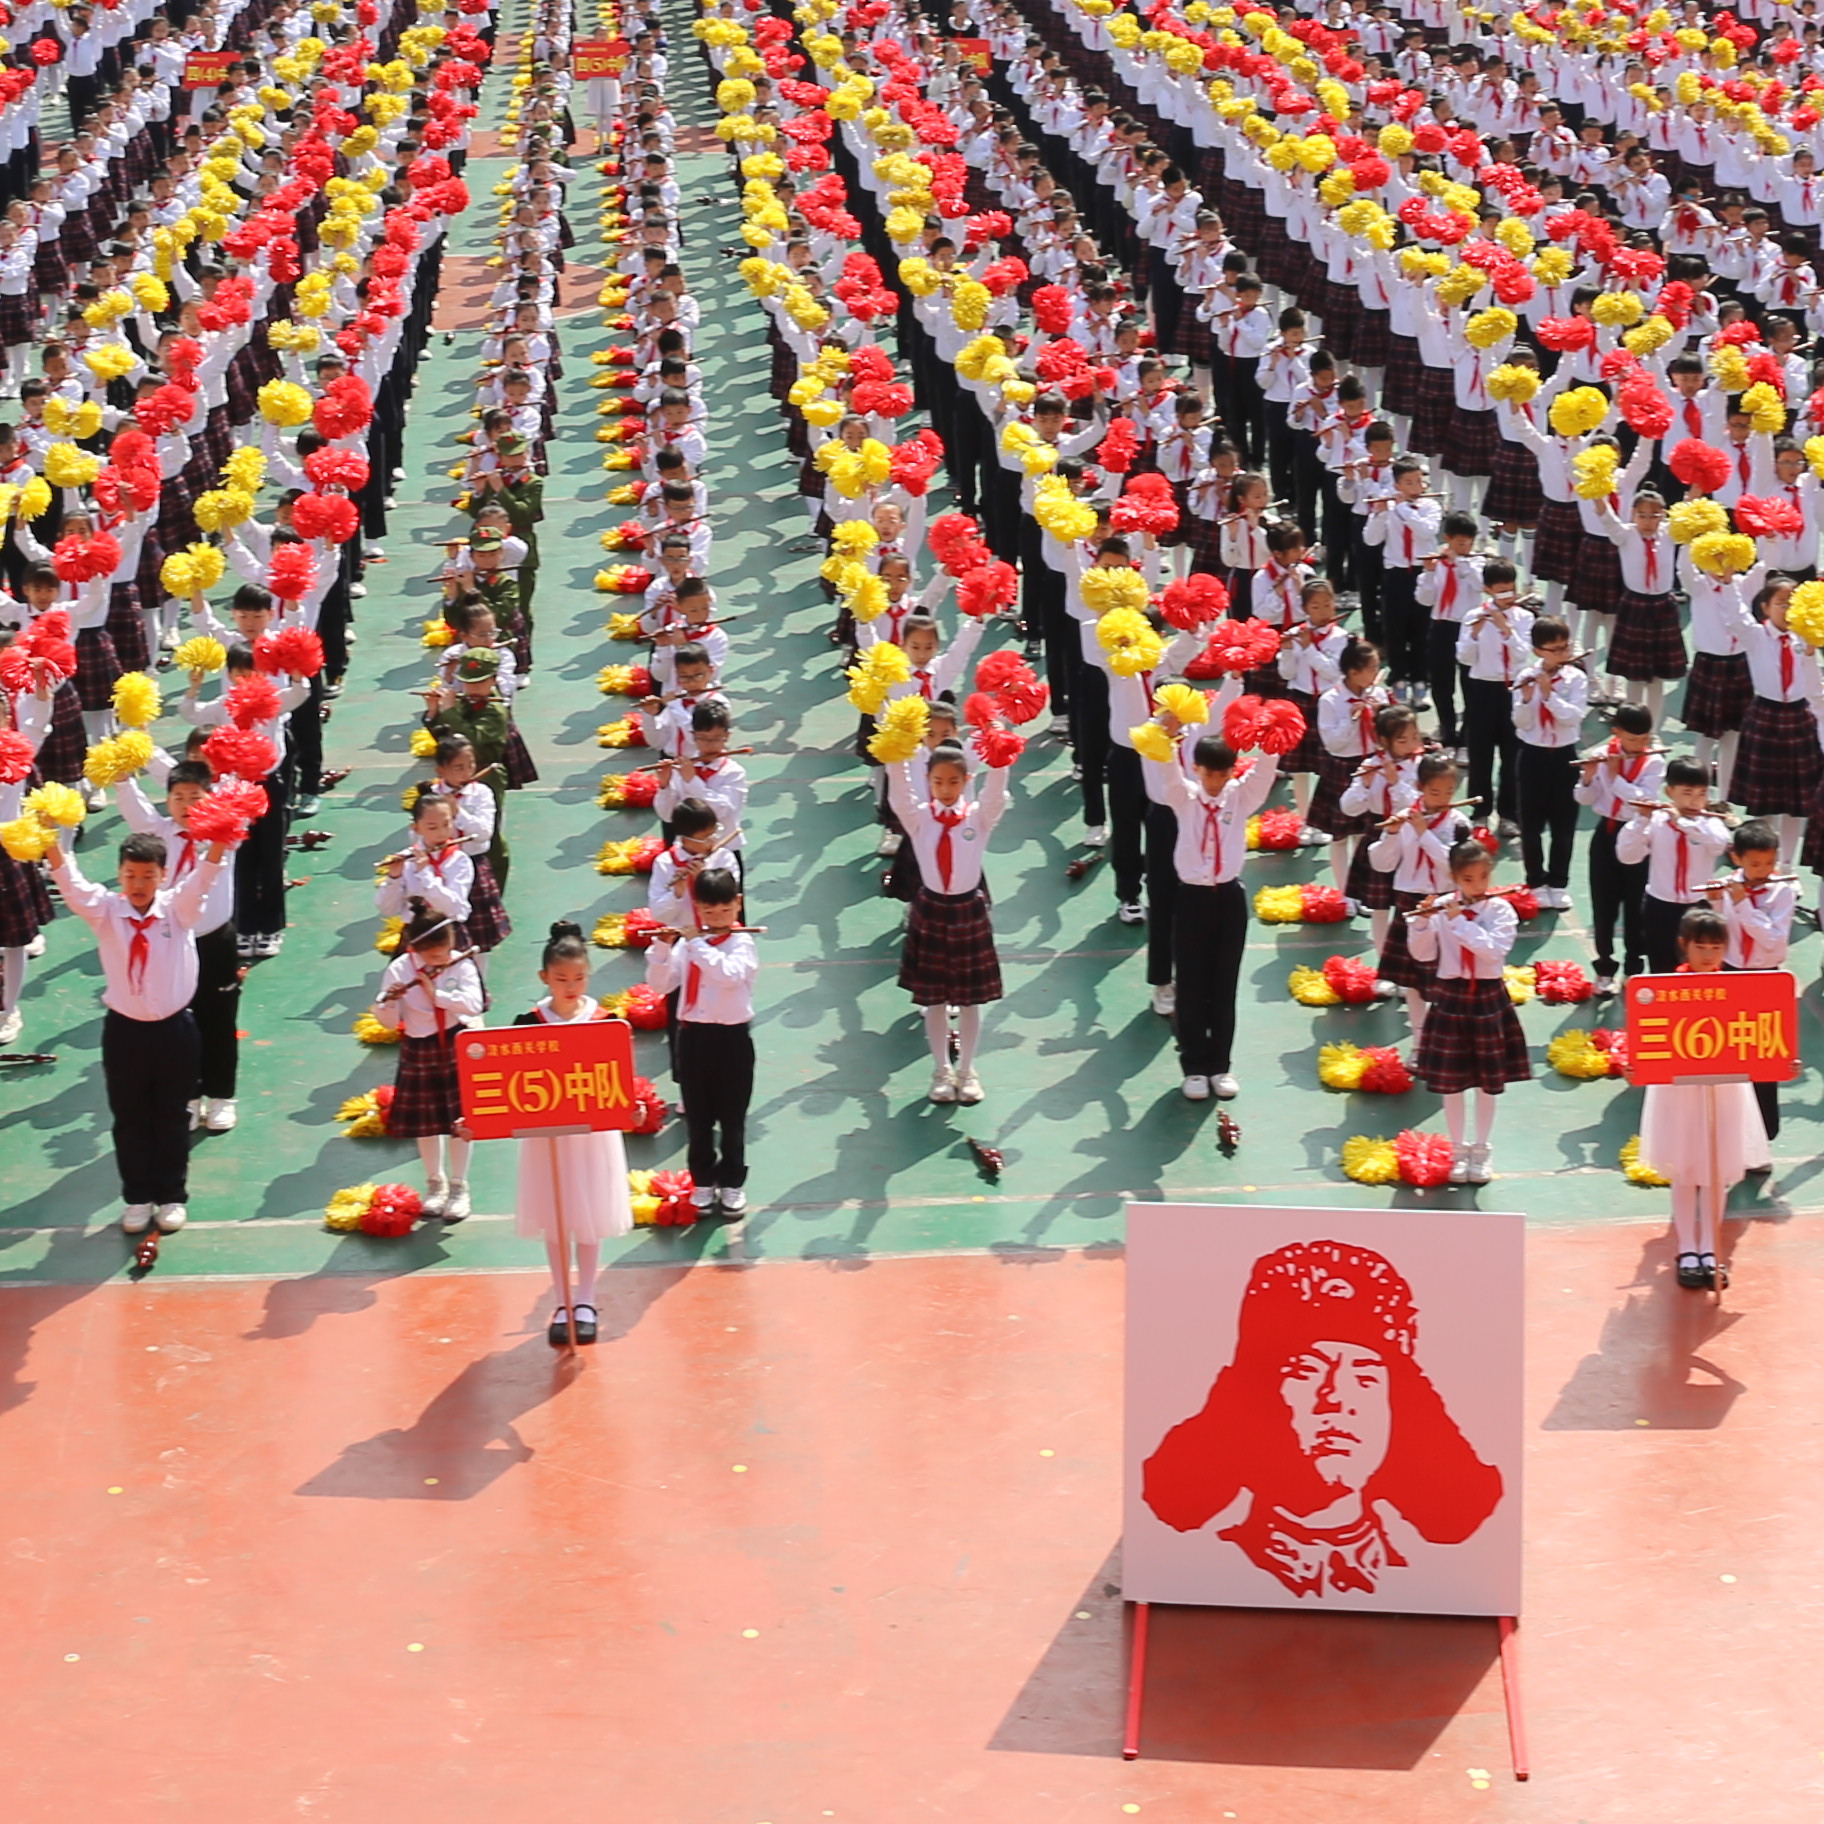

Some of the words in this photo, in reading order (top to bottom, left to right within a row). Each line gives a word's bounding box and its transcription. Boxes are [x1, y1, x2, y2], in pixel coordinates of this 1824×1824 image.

[1635, 1010, 1790, 1061] 三(6)中队
[471, 1060, 630, 1116] 三(5)中队
